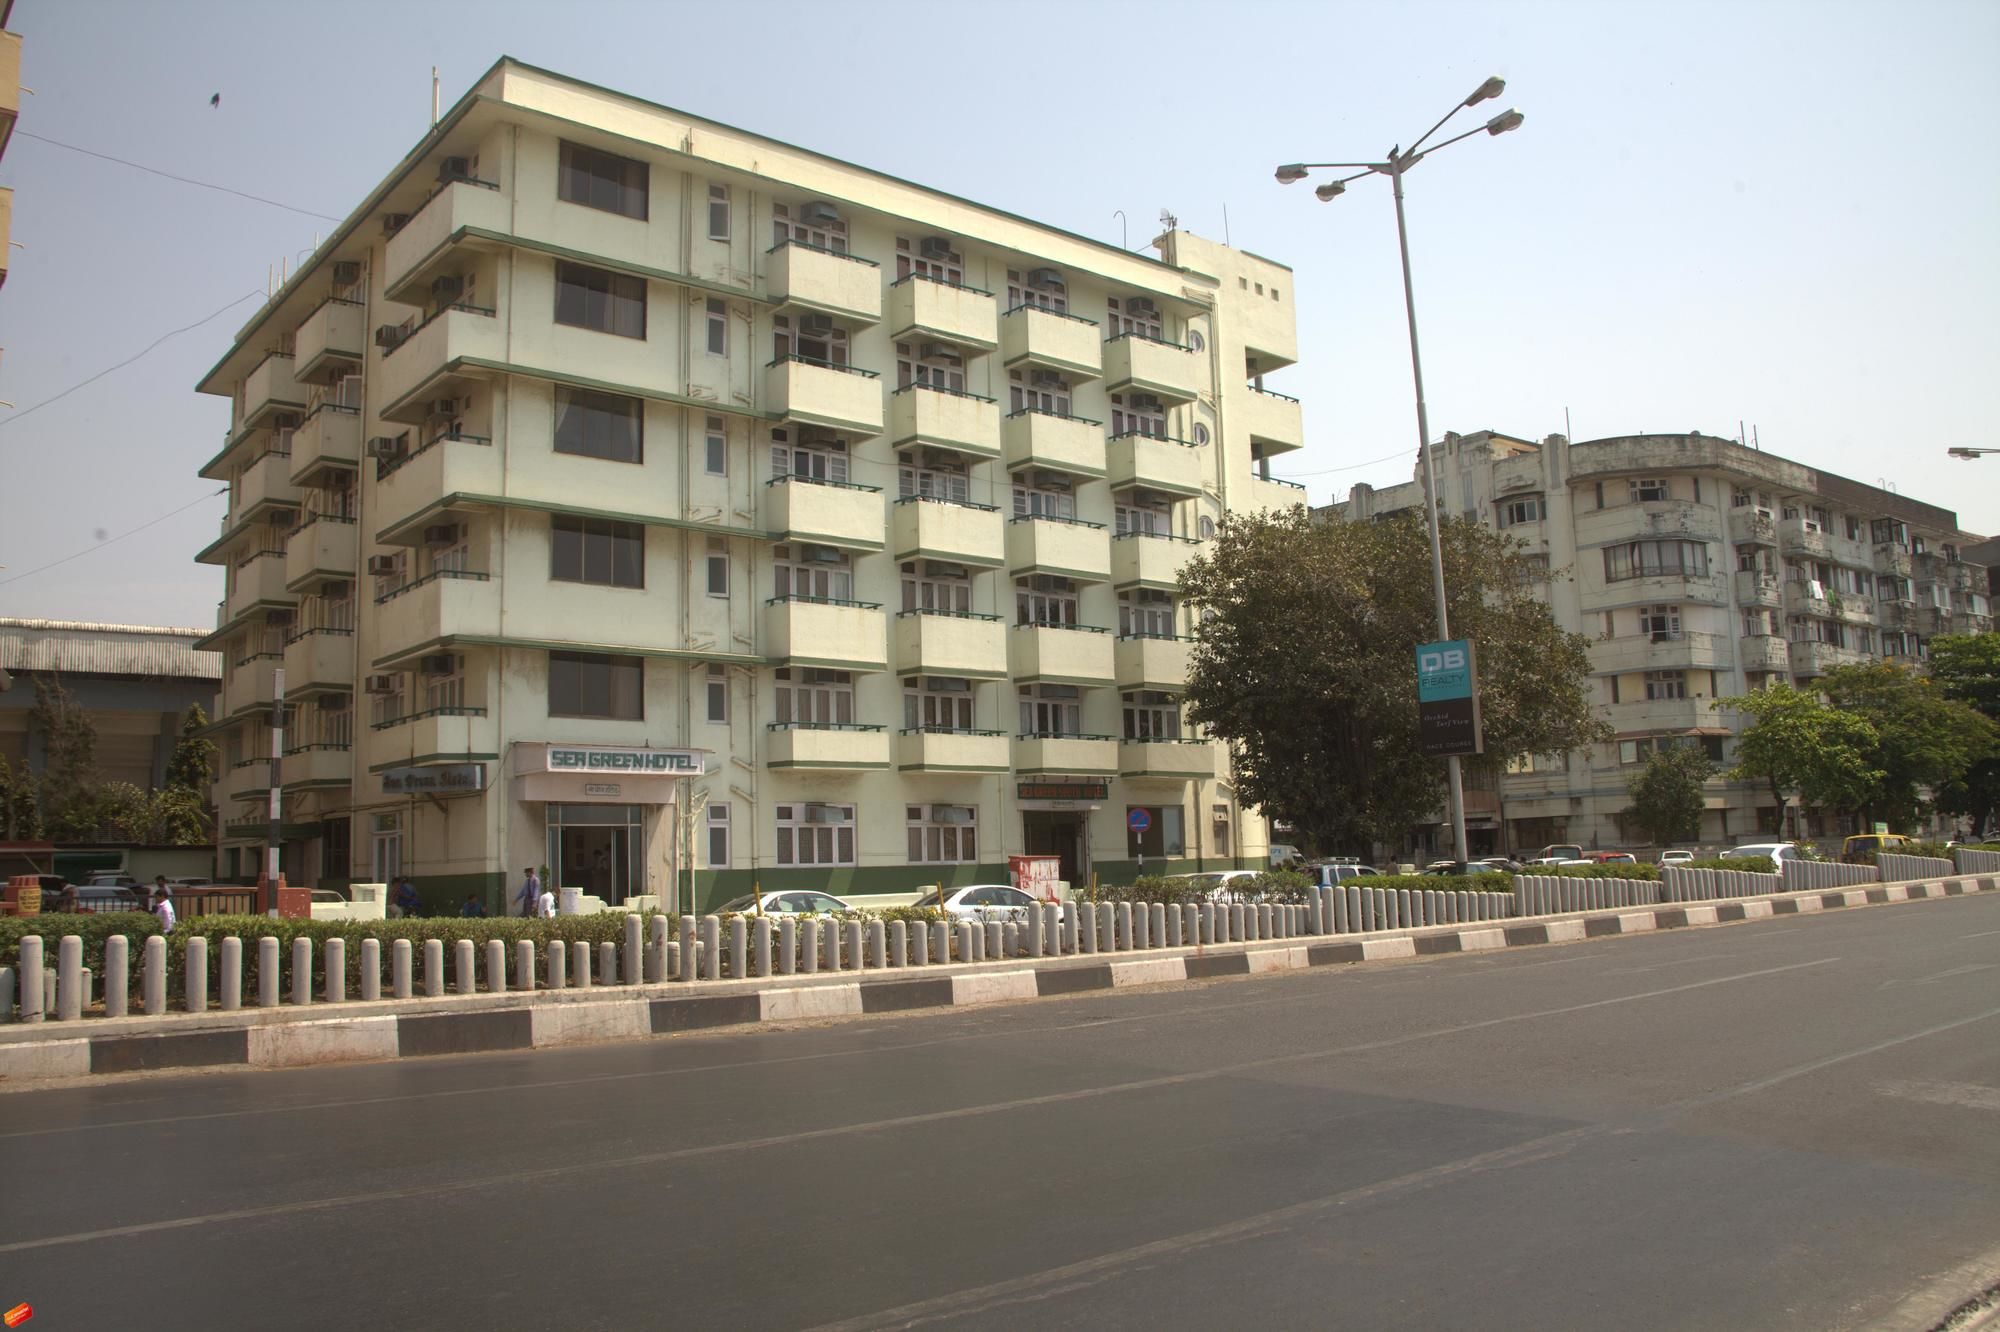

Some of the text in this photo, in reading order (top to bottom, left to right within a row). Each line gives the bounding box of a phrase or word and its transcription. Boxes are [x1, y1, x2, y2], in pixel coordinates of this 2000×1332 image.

[1421, 650, 1465, 672] DB
[1422, 674, 1464, 687] REALTY
[551, 751, 698, 769] SEA GREEN HOTEL
